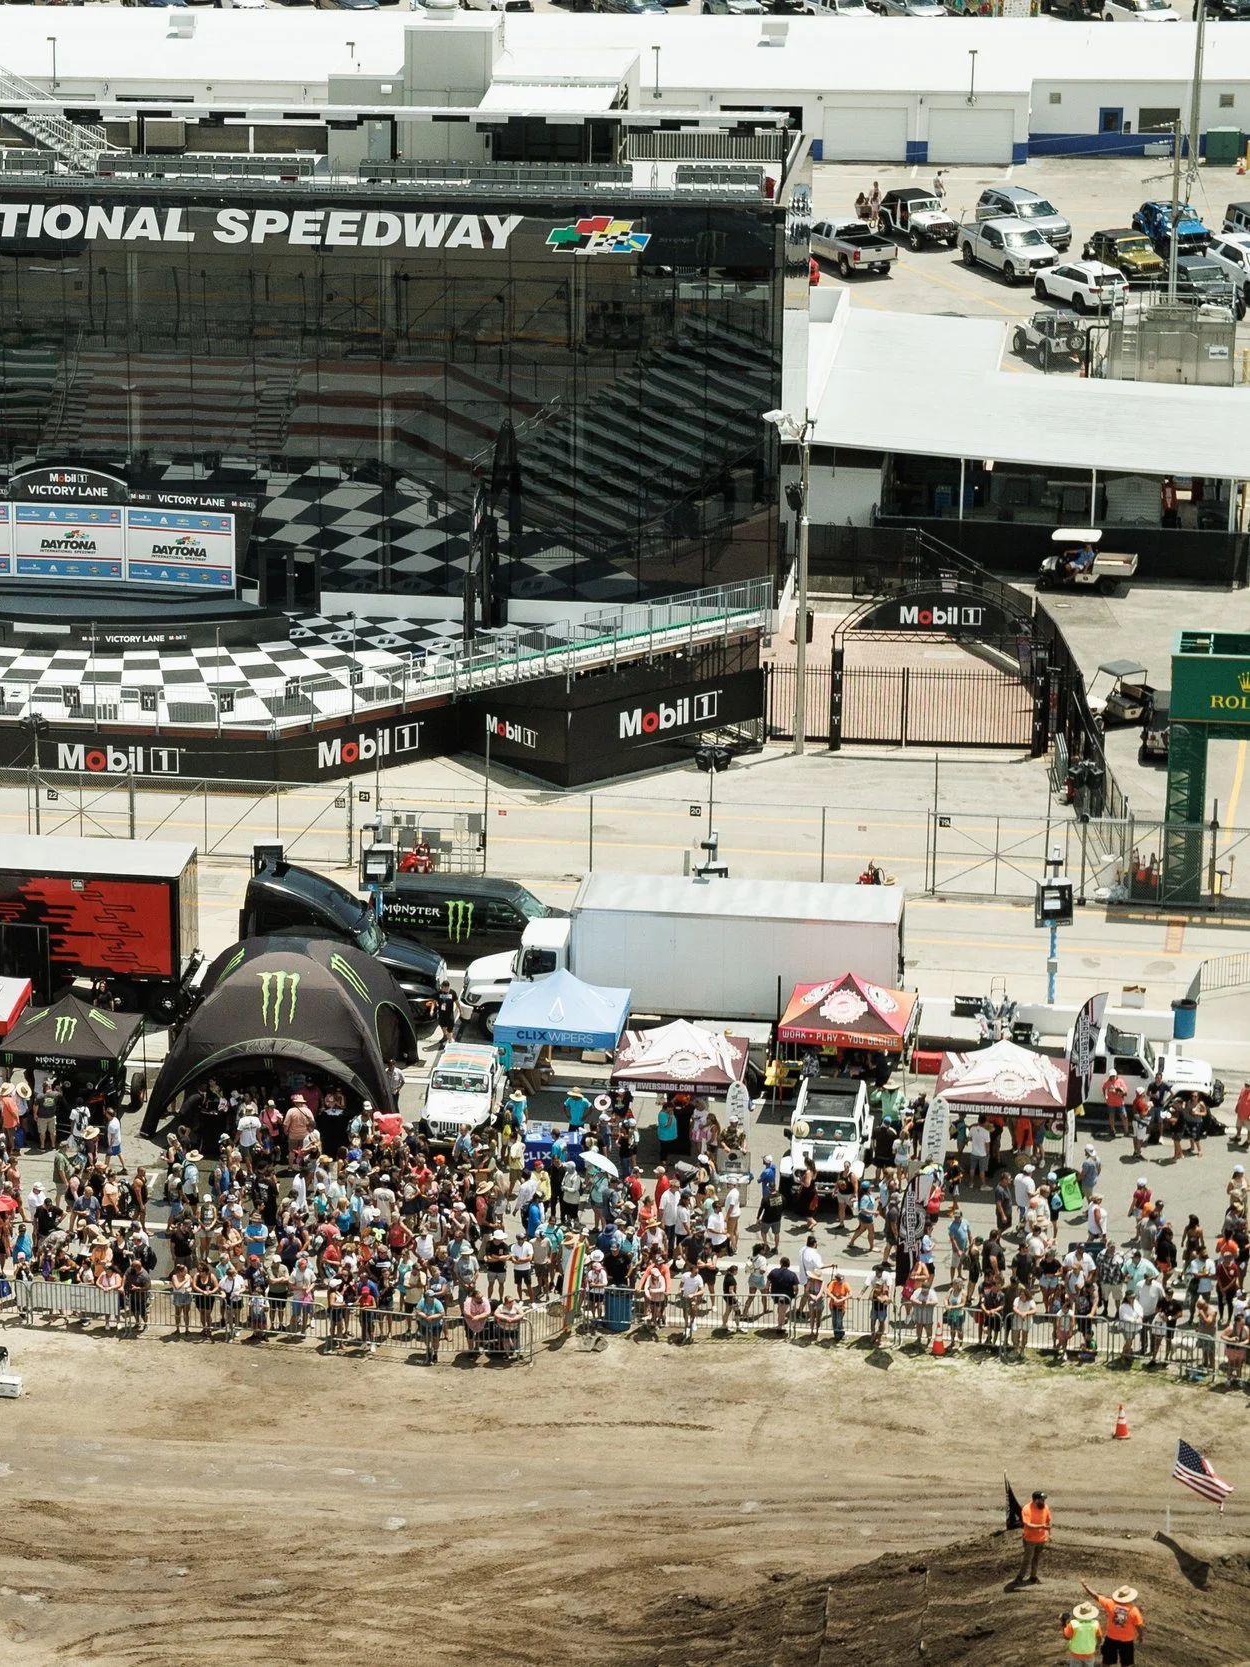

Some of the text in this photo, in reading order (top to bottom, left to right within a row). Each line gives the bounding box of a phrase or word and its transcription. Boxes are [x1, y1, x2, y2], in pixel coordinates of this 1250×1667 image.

[213, 208, 523, 249] SPEEDWAY
[50, 474, 76, 483] Mobil
[28, 485, 108, 497] VICTORY LANE
[158, 495, 225, 507] VICTORY LANE
[41, 539, 96, 550] DAYTONA
[152, 544, 207, 558] DAYTONA
[900, 606, 958, 625] Mobil
[105, 635, 141, 643] VICTORY
[143, 635, 165, 643] LANE
[619, 697, 689, 739] Mobil
[486, 713, 522, 743] Mobil
[318, 728, 390, 768] Mobil
[58, 743, 144, 772] Mobil
[48, 791, 58, 799] 22
[691, 807, 701, 816] 20
[382, 904, 440, 917] MONSTER
[816, 1033, 838, 1042] PLAY
[35, 1056, 76, 1066] MONSTER
